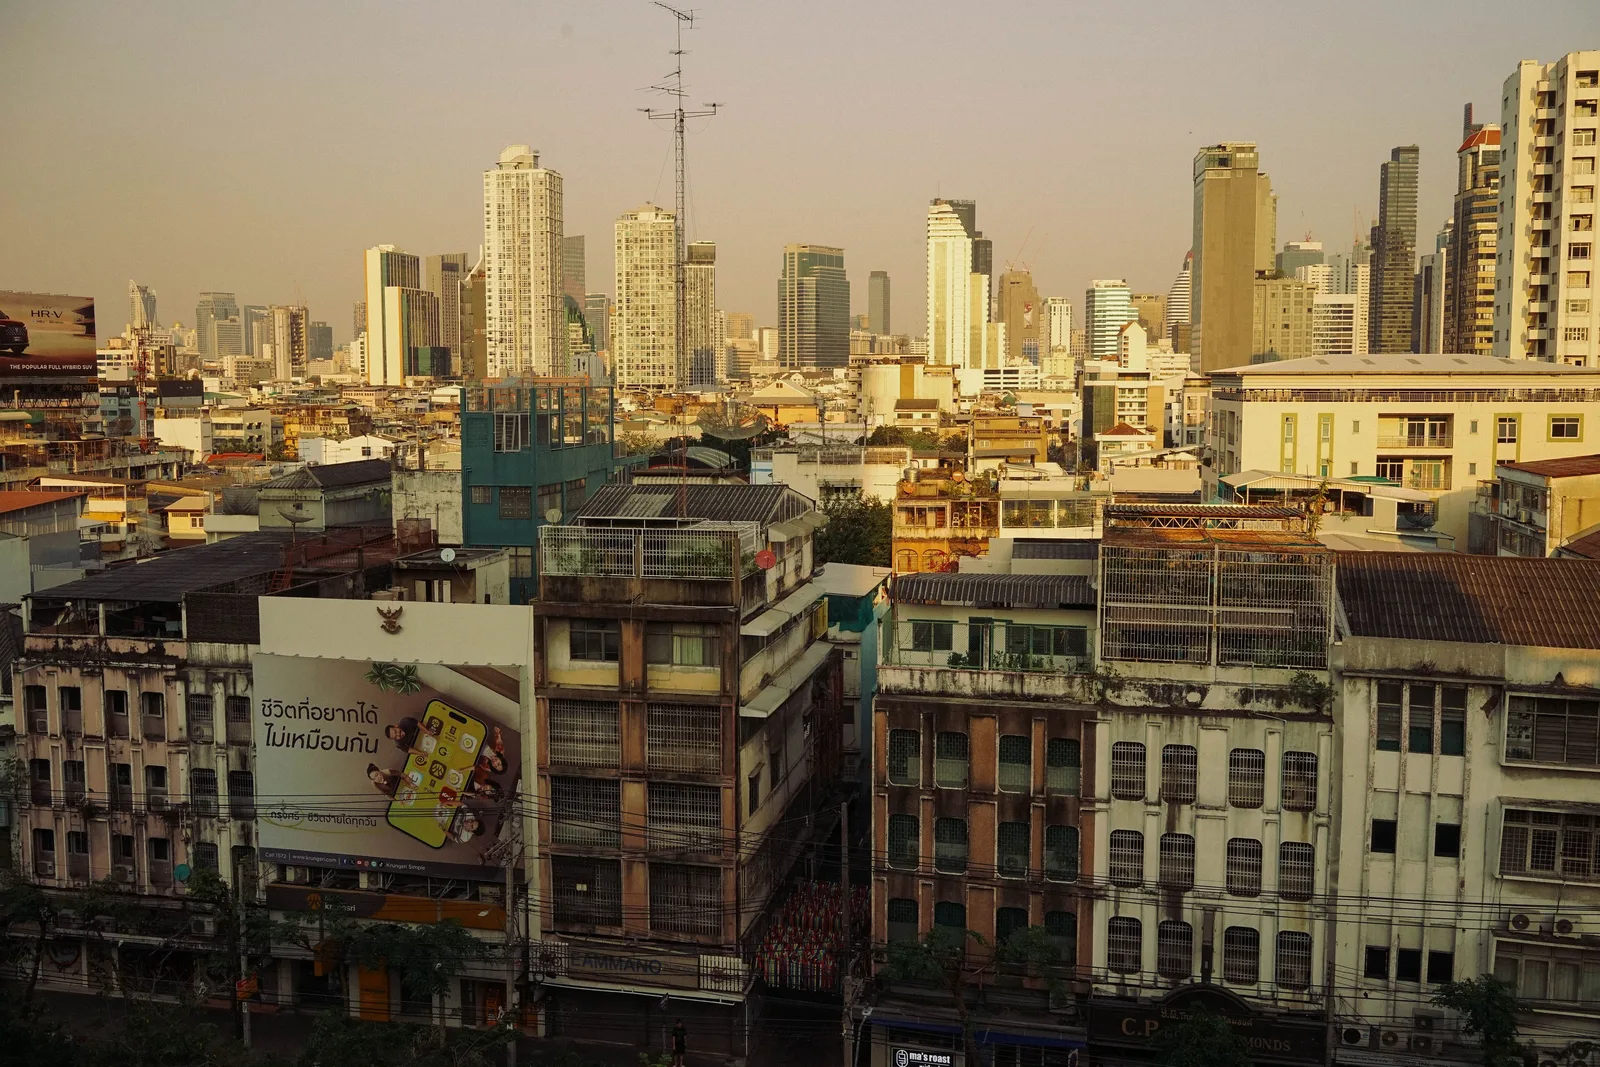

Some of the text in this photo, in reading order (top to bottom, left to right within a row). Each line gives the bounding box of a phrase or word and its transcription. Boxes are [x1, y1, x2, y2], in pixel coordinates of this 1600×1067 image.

[31, 309, 63, 319] HR-V
[261, 696, 379, 725] ชีวิตที่อยากได้
[264, 722, 379, 754] ไม่เหมือนกัน
[292, 854, 337, 863] www.krungsri.com
[386, 863, 408, 871] Krungsri
[909, 1052, 951, 1064] ma's roast
